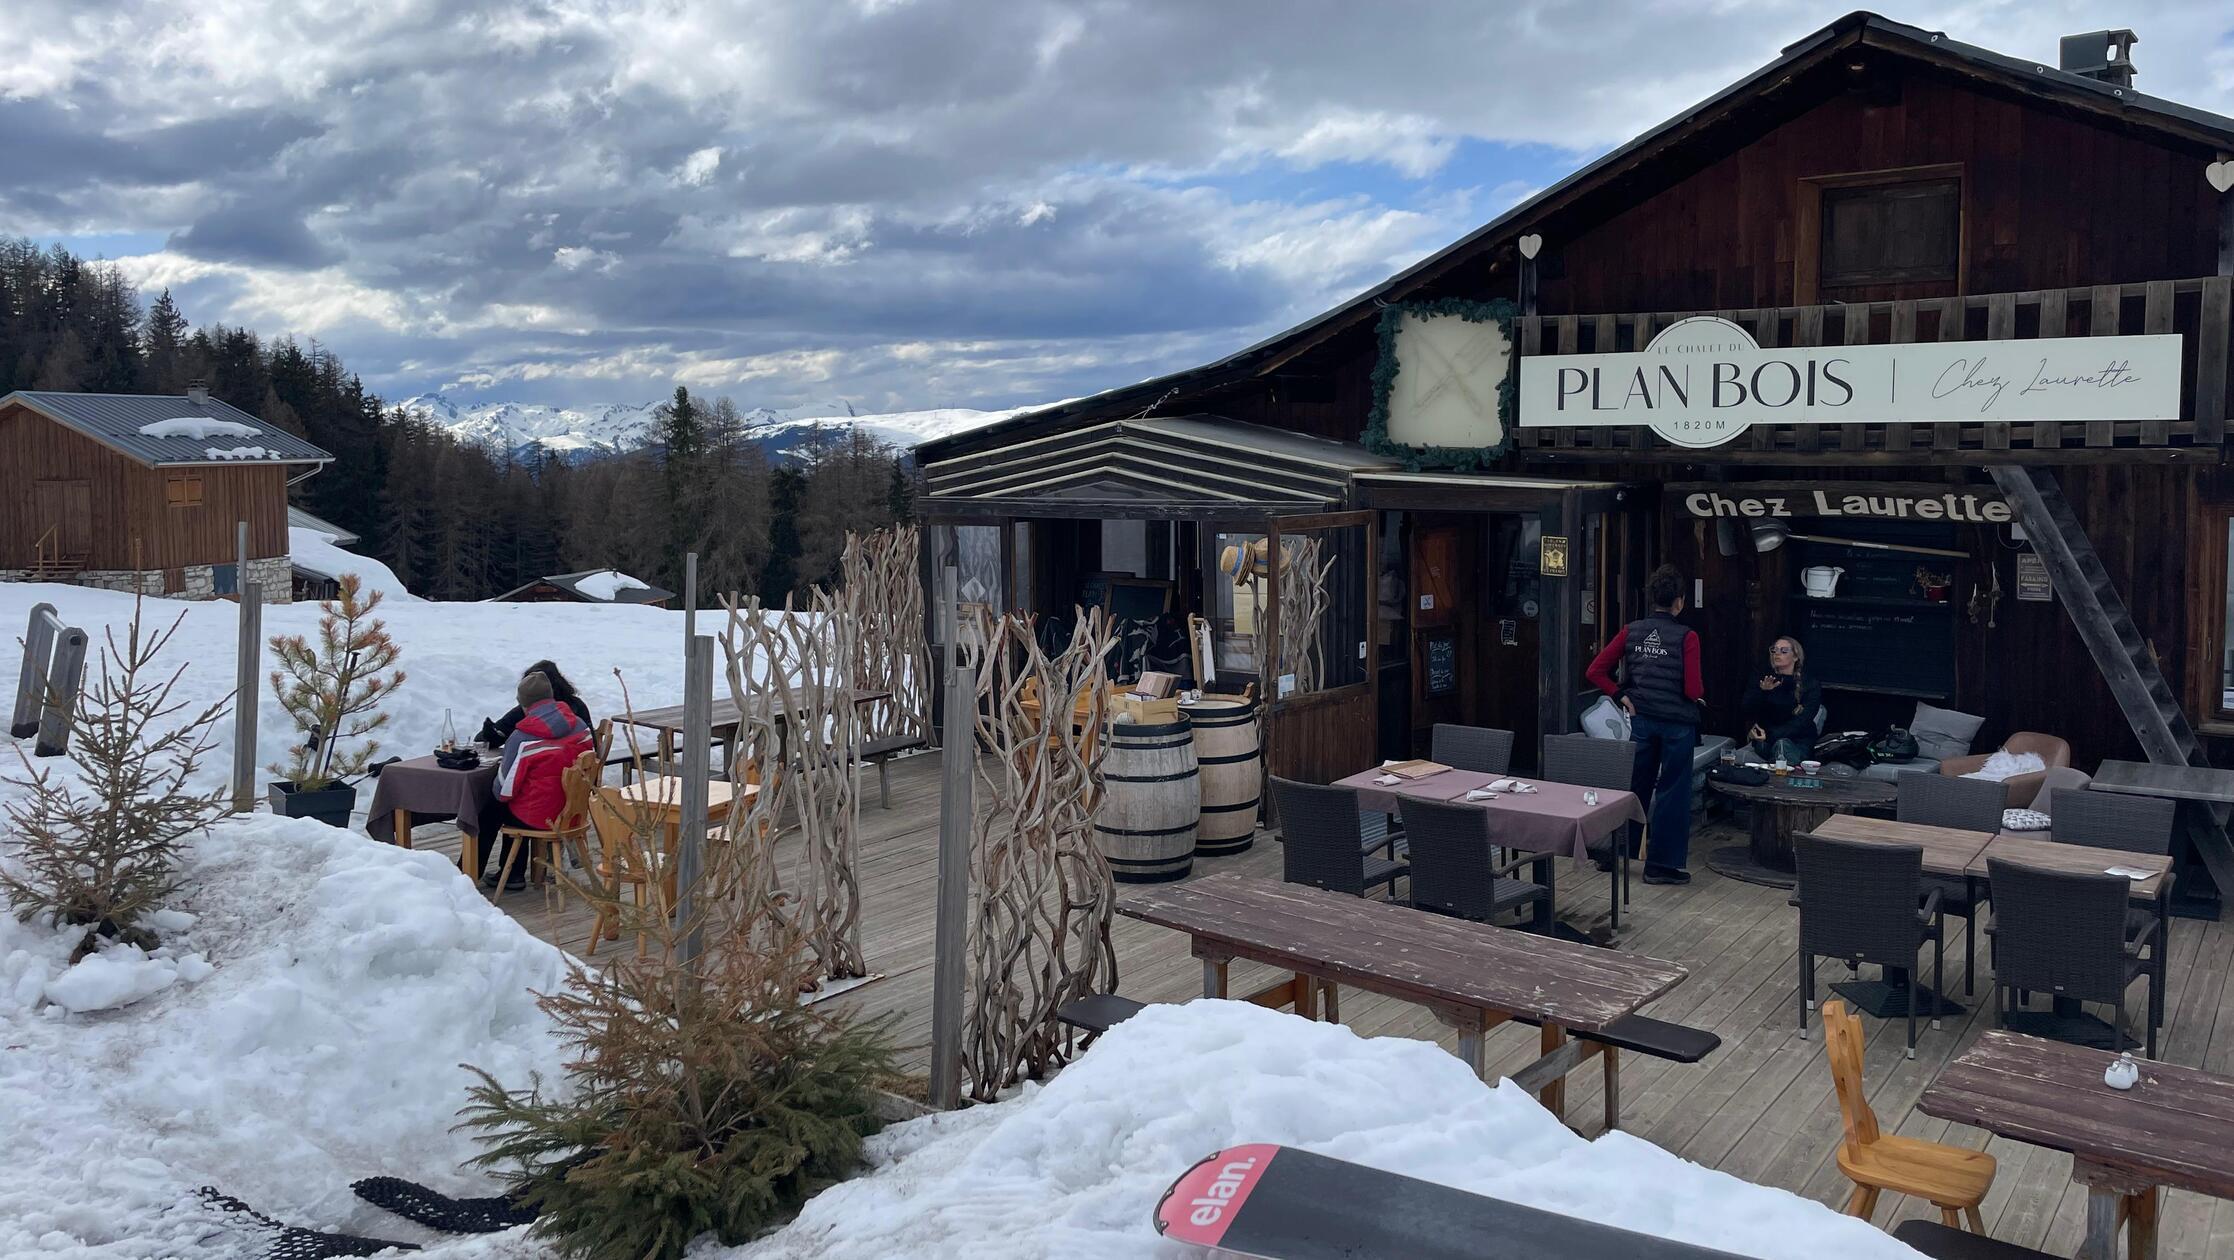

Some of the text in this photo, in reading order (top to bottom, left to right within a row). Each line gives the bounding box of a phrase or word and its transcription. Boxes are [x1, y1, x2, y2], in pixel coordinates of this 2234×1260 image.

[1677, 343, 1723, 353] CHALET
[1729, 343, 1743, 352] DU
[1557, 358, 1853, 411] PLAN BOIS
[1931, 356, 2142, 413] Chez Laurette
[1673, 420, 1726, 431] 1820M
[1686, 490, 2012, 522] Chez Laurette
[1634, 645, 1668, 656] PLAN BOIS
